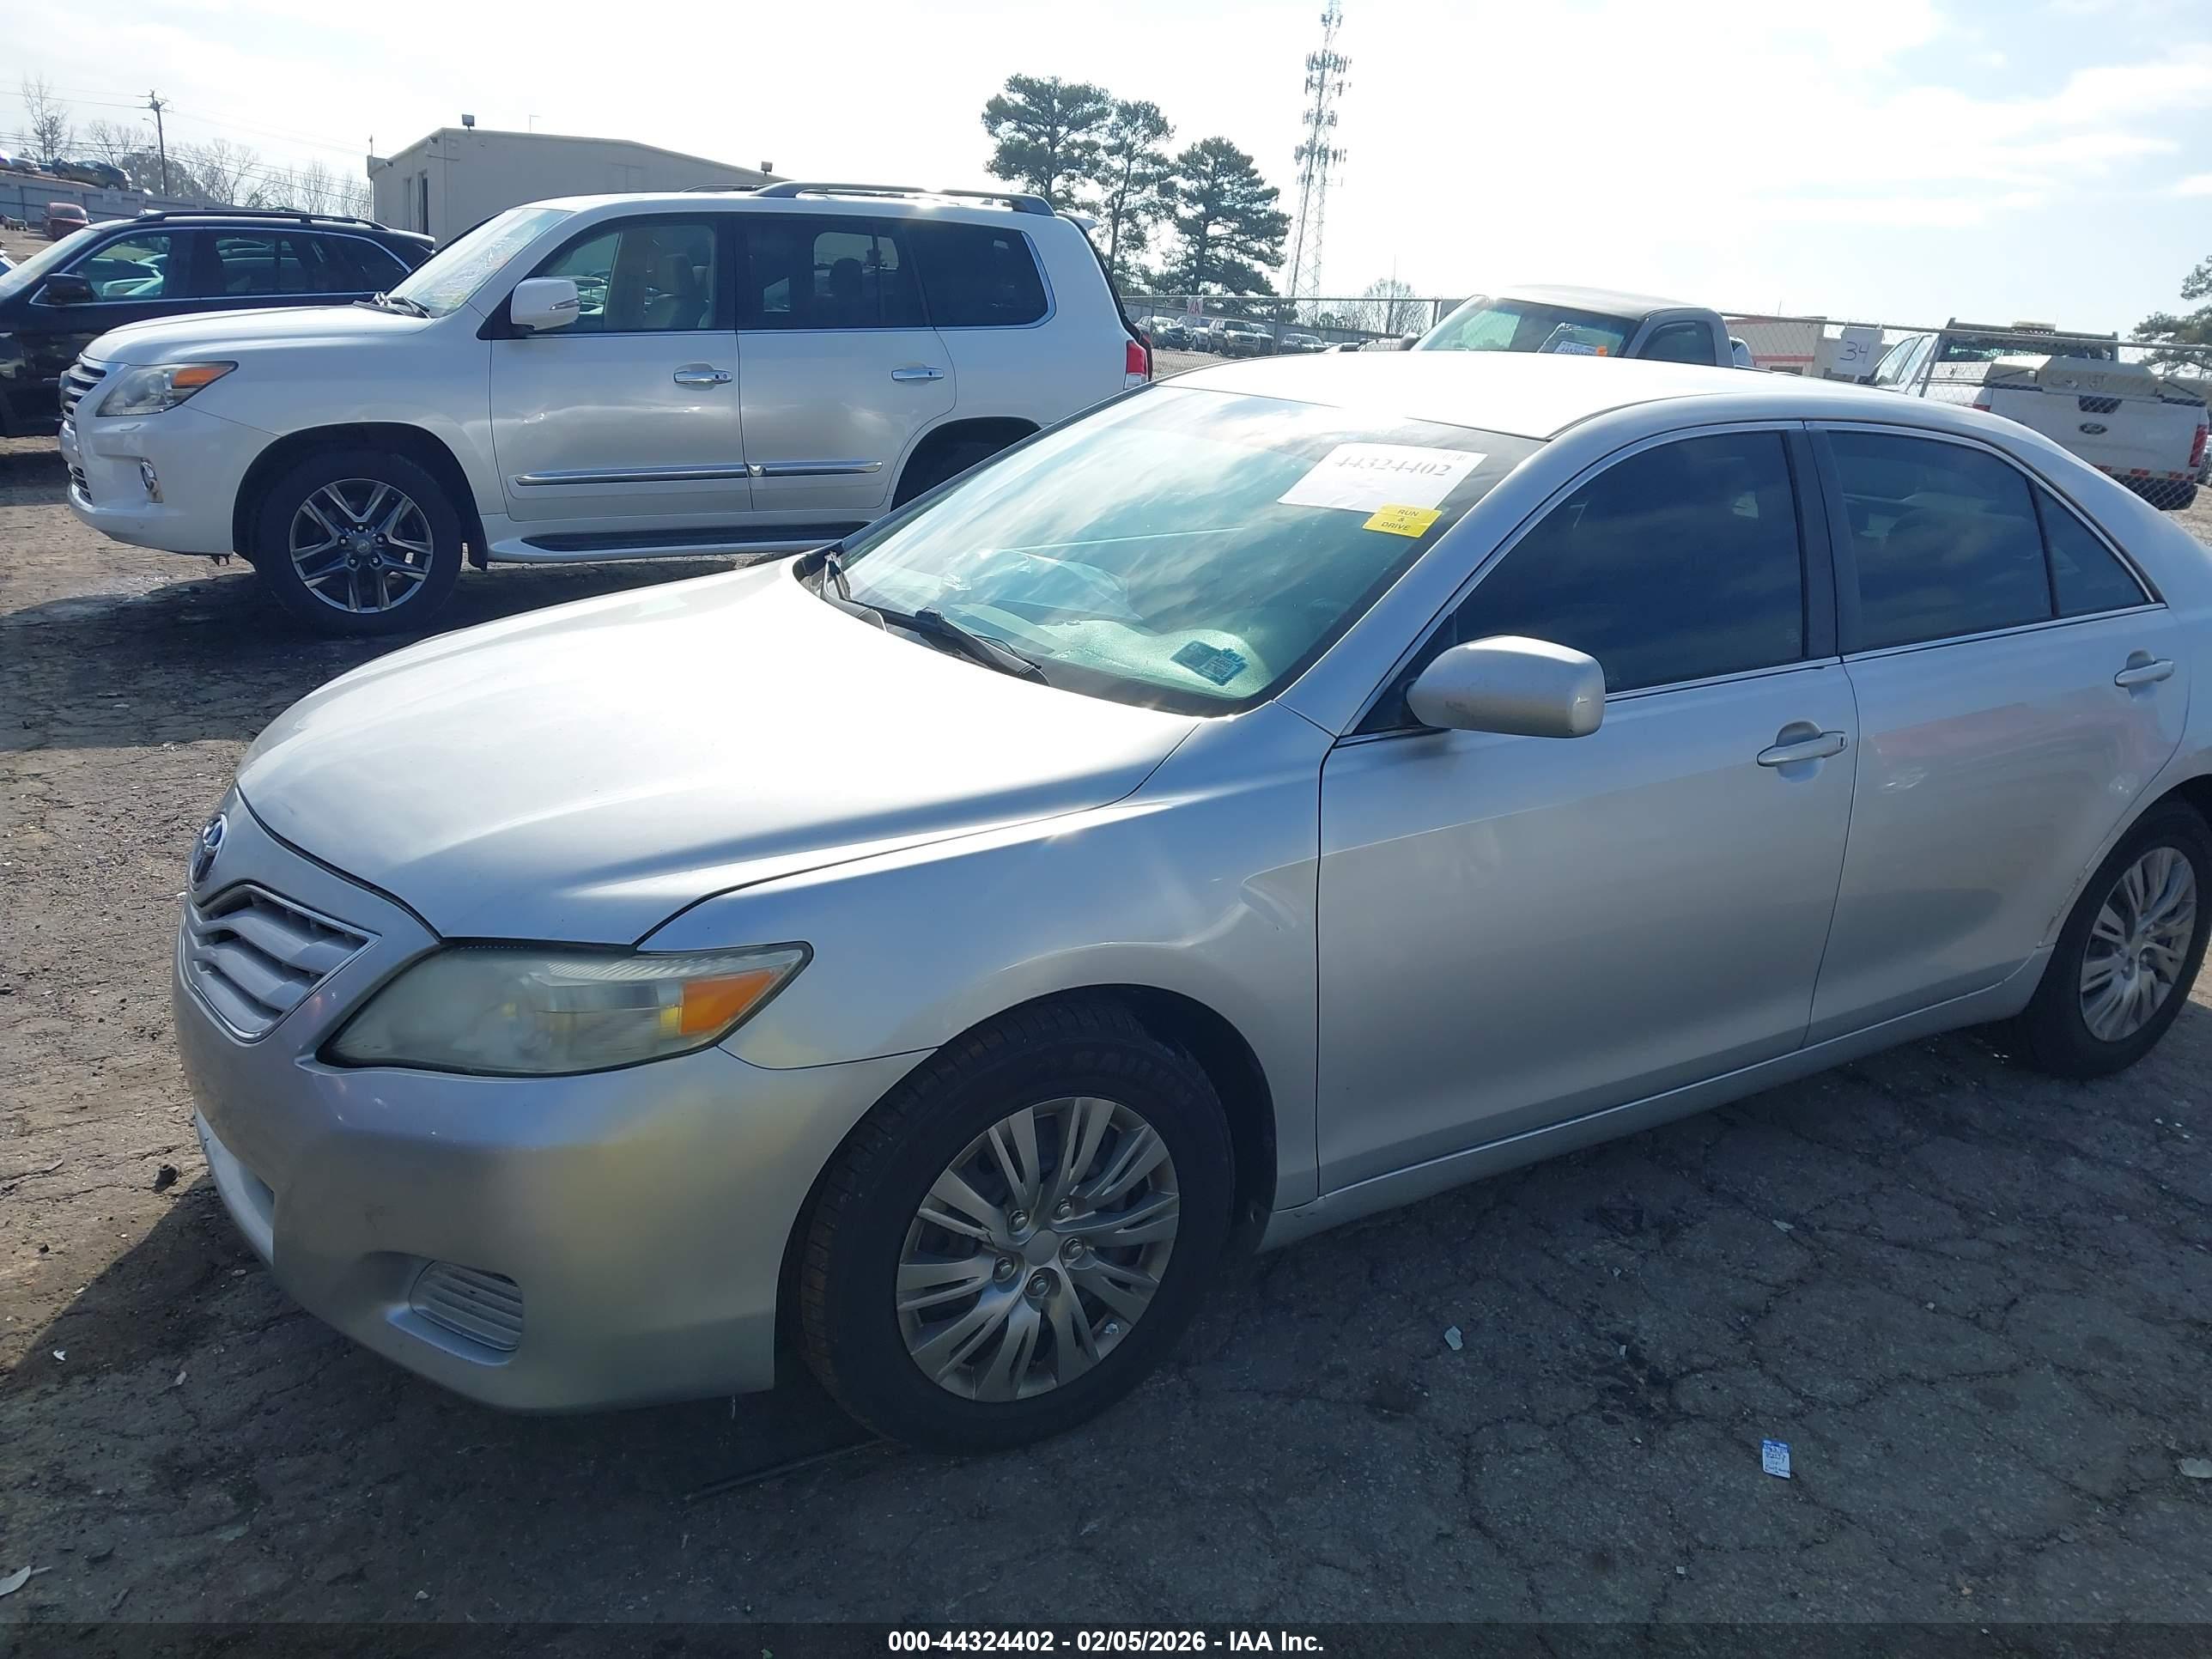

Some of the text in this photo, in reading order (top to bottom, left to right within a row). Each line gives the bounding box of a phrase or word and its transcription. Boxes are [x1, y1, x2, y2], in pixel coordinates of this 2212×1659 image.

[1839, 341, 1870, 364] 34
[1333, 455, 1452, 477] 44324402
[1396, 508, 1419, 517] RUN
[1381, 521, 1412, 531] DRIVE
